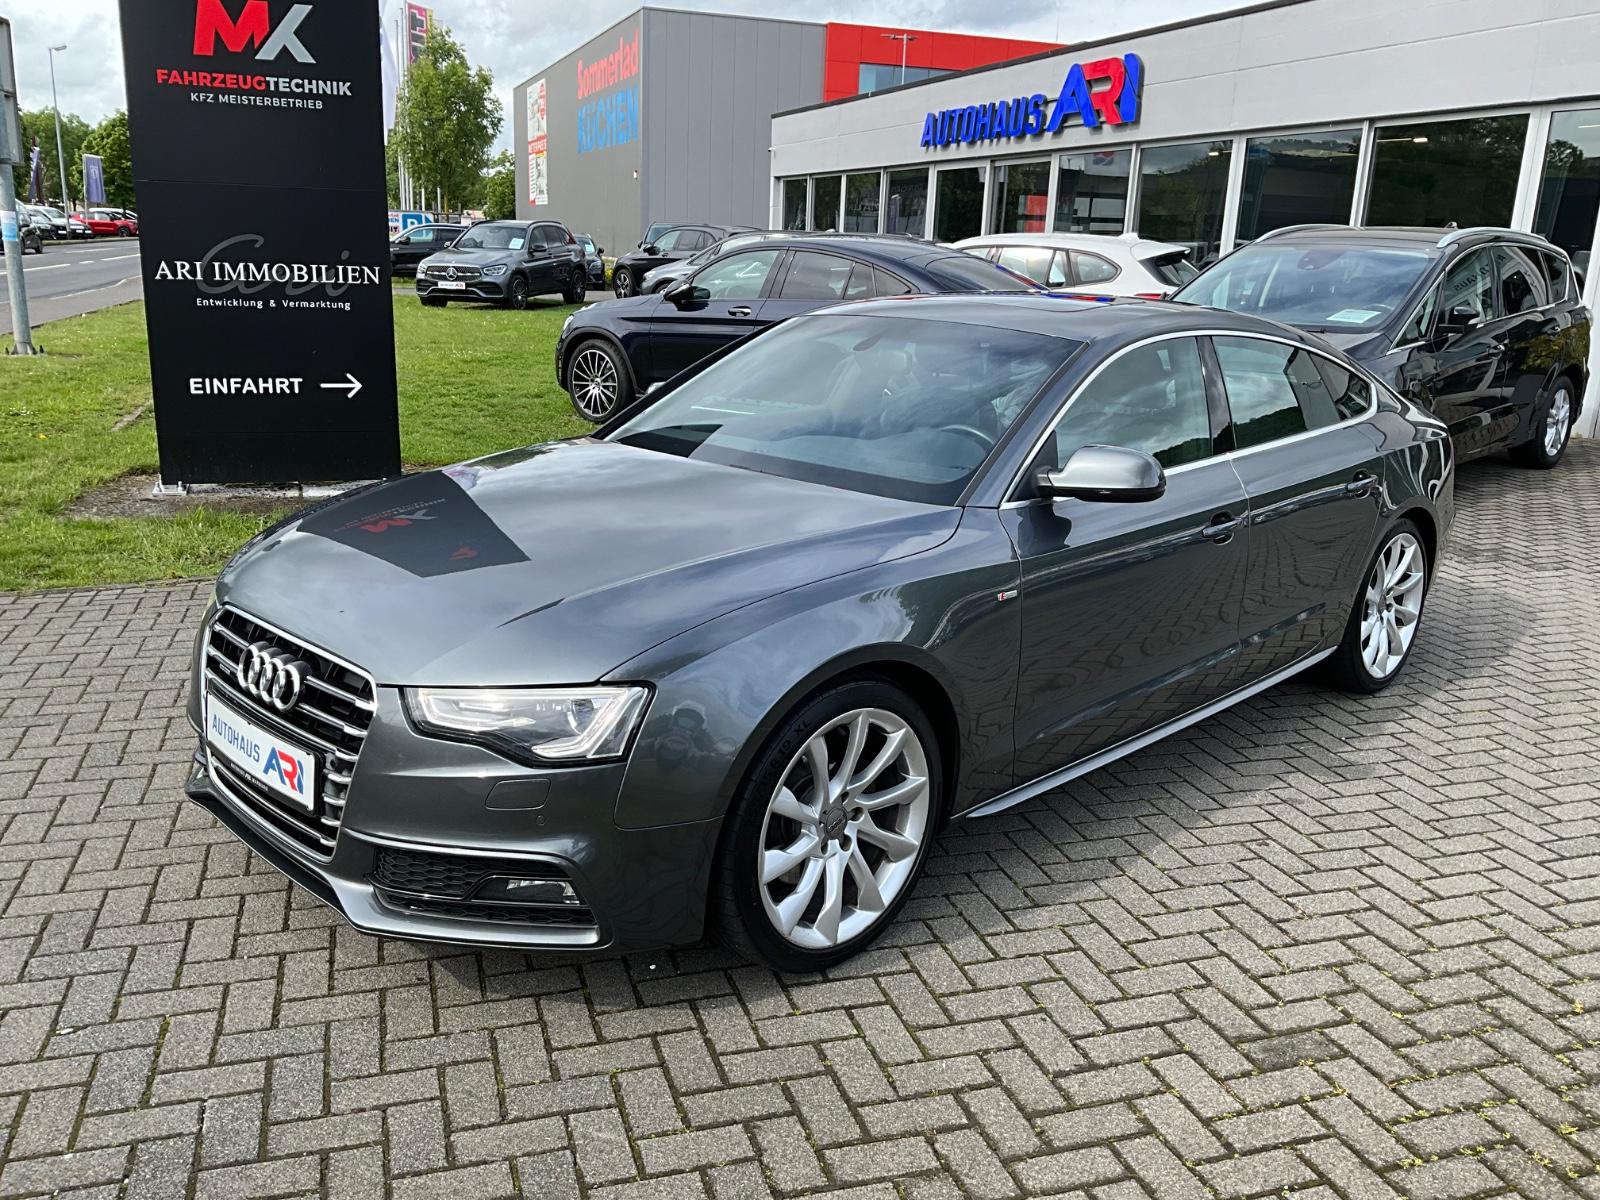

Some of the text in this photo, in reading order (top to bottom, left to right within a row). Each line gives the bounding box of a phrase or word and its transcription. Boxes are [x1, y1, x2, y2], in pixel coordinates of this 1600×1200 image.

[577, 31, 639, 99] Sommerlad
[157, 70, 352, 96] FAHRZEUGTECHNIK
[190, 92, 323, 109] KFZ MEISTERBETRIEB
[920, 53, 1144, 148] AUTOHAUS ARI
[155, 260, 380, 285] ARI IMMOBILIEN
[196, 298, 351, 311] Entwicklung & Vermarktung
[189, 377, 303, 395] EINFAHRT
[212, 714, 261, 763] AUTOHAUS
[263, 746, 304, 795] ARI
